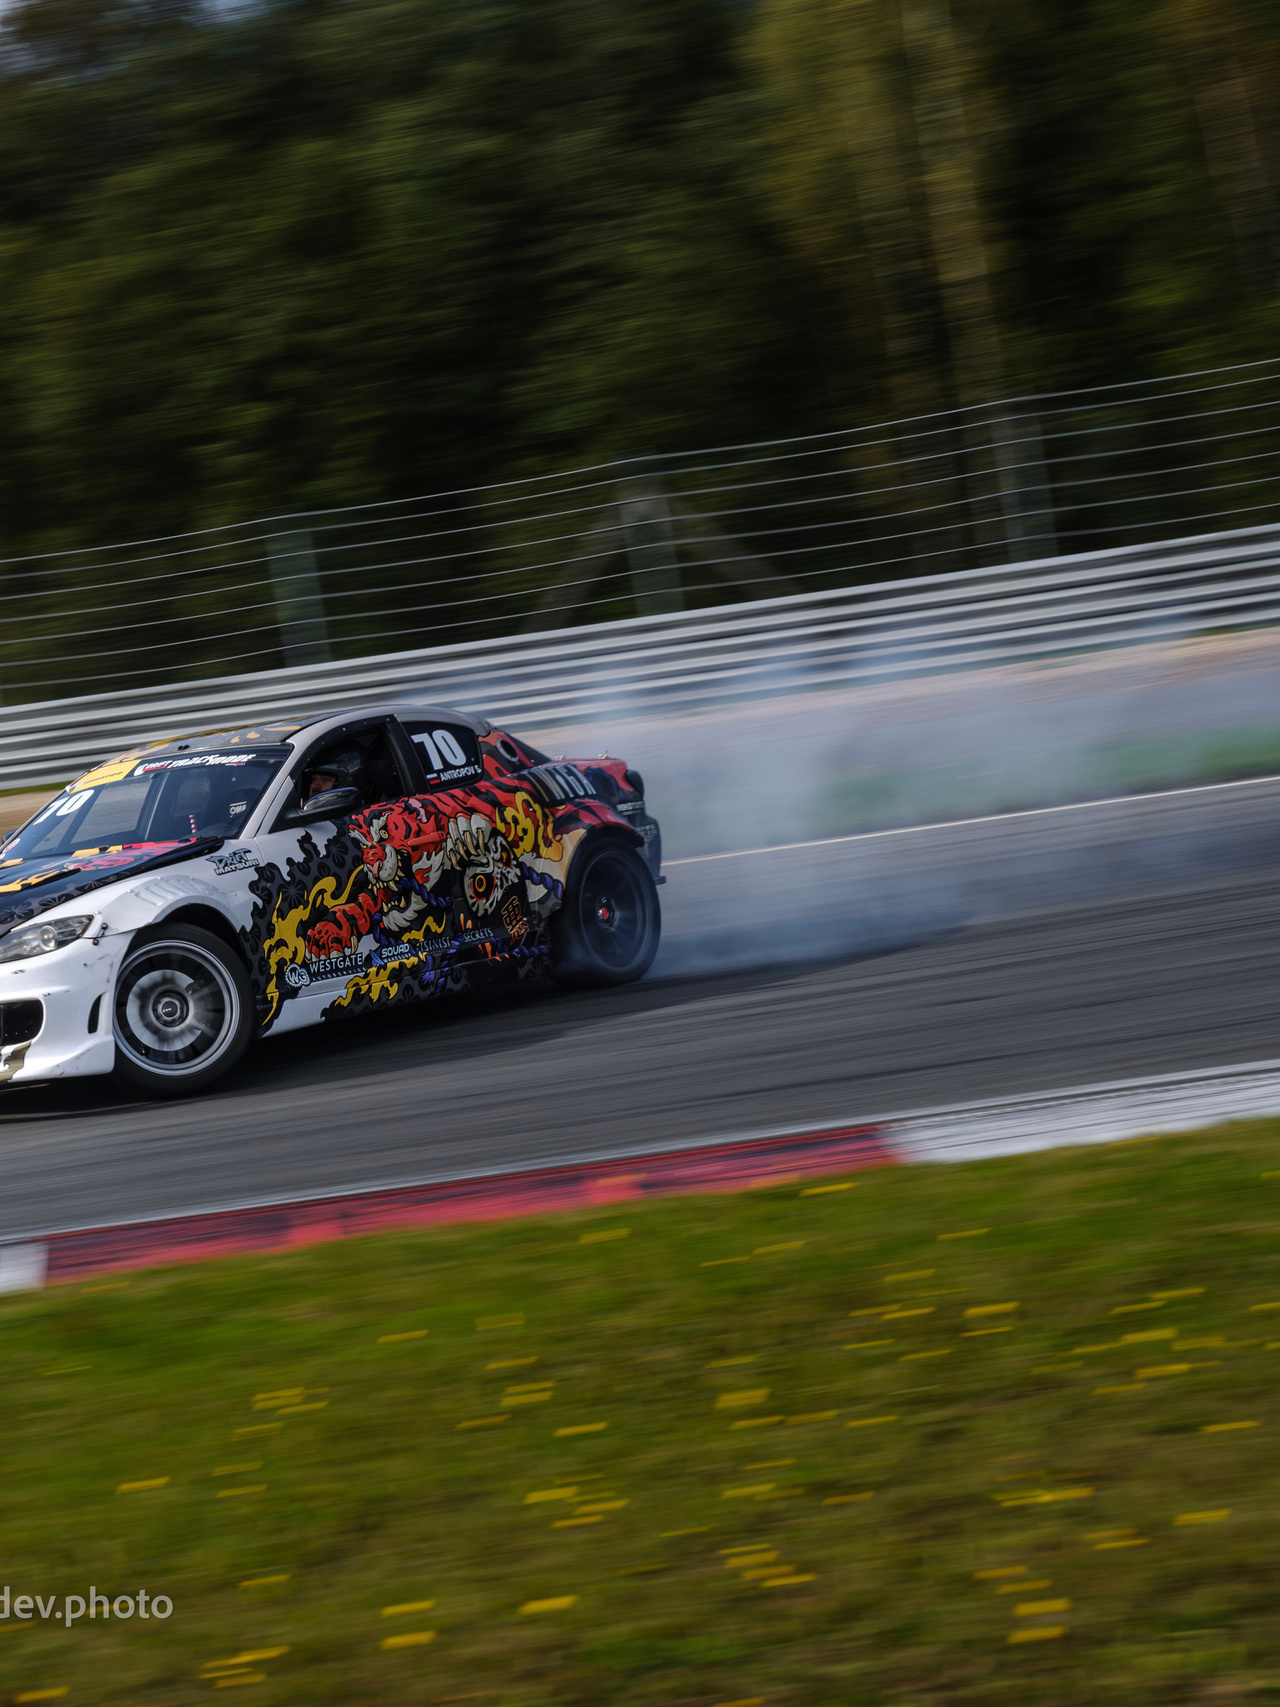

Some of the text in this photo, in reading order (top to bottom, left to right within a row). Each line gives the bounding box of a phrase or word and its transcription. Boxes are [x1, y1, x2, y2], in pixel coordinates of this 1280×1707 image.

[410, 729, 467, 771] 70
[33, 789, 95, 826] 70
[214, 859, 260, 875] MATSURI
[463, 927, 494, 943] SECRETS
[381, 943, 410, 958] SQUAD
[309, 953, 363, 974] WESTGATE
